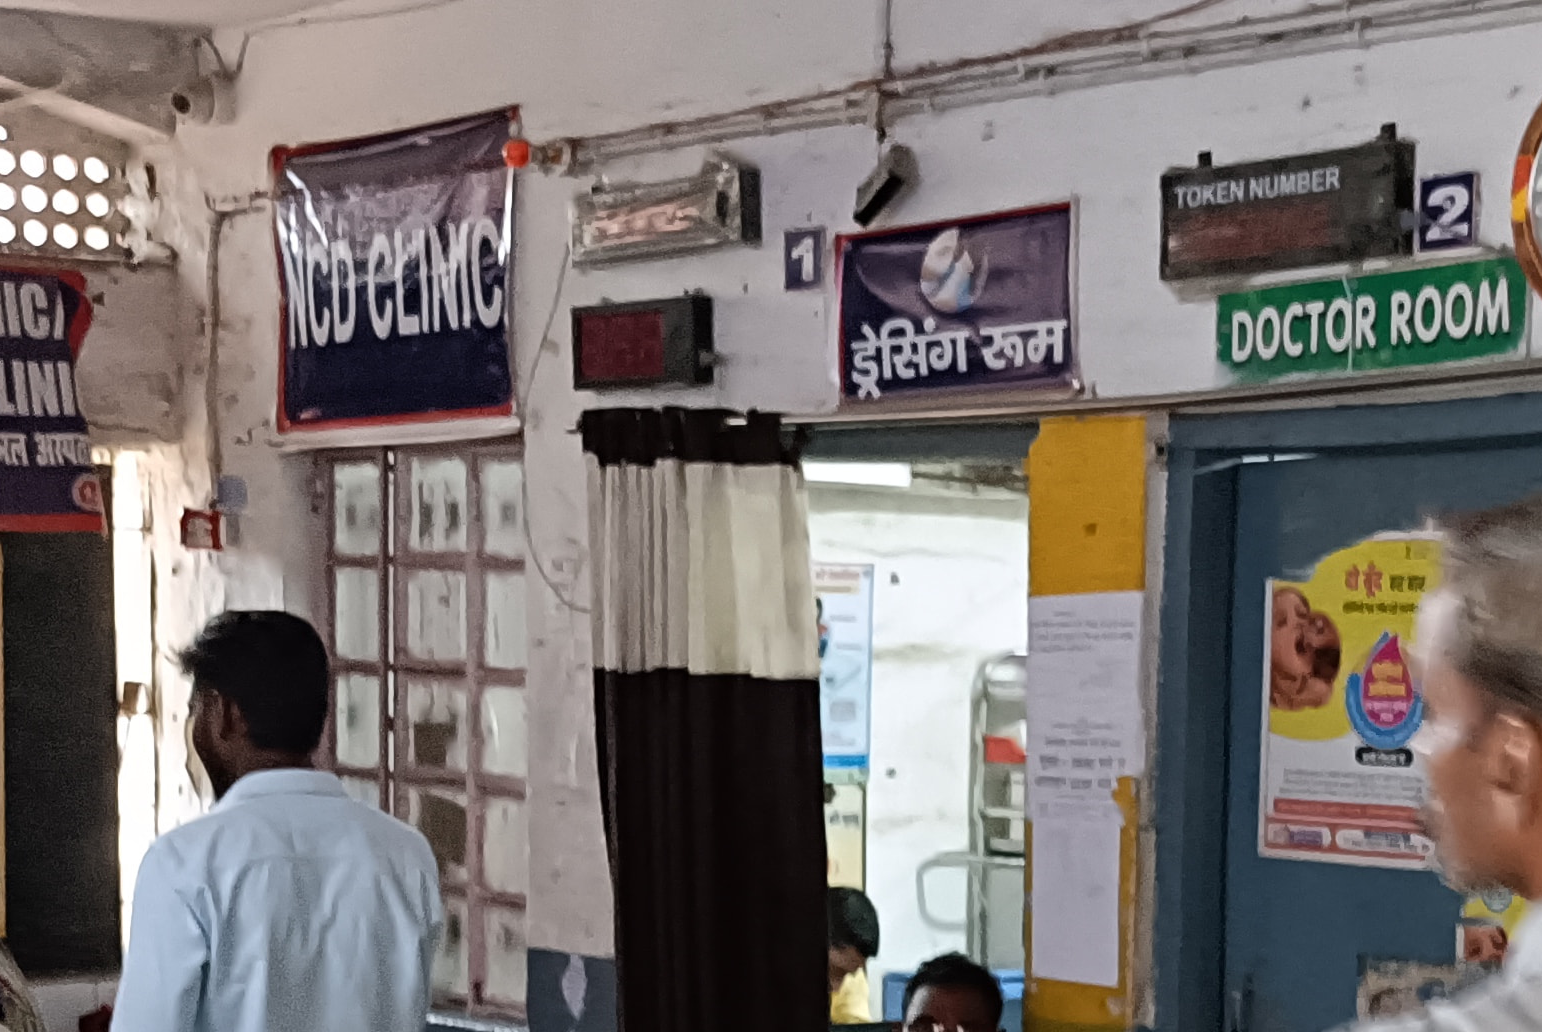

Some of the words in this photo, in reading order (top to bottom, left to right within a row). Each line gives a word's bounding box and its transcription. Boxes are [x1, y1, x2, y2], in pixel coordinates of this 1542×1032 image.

[1175, 178, 1245, 208] TOKEN
[1249, 166, 1341, 199] NUMBER
[1425, 183, 1470, 242] 2
[277, 225, 357, 350] NCD
[368, 216, 503, 341] CLINIC
[790, 238, 815, 283] 1
[1230, 293, 1377, 364] DOCTOR
[1389, 276, 1511, 346] ROOM
[852, 316, 968, 398] ड्रेसिंग
[980, 318, 1068, 371] रूम
